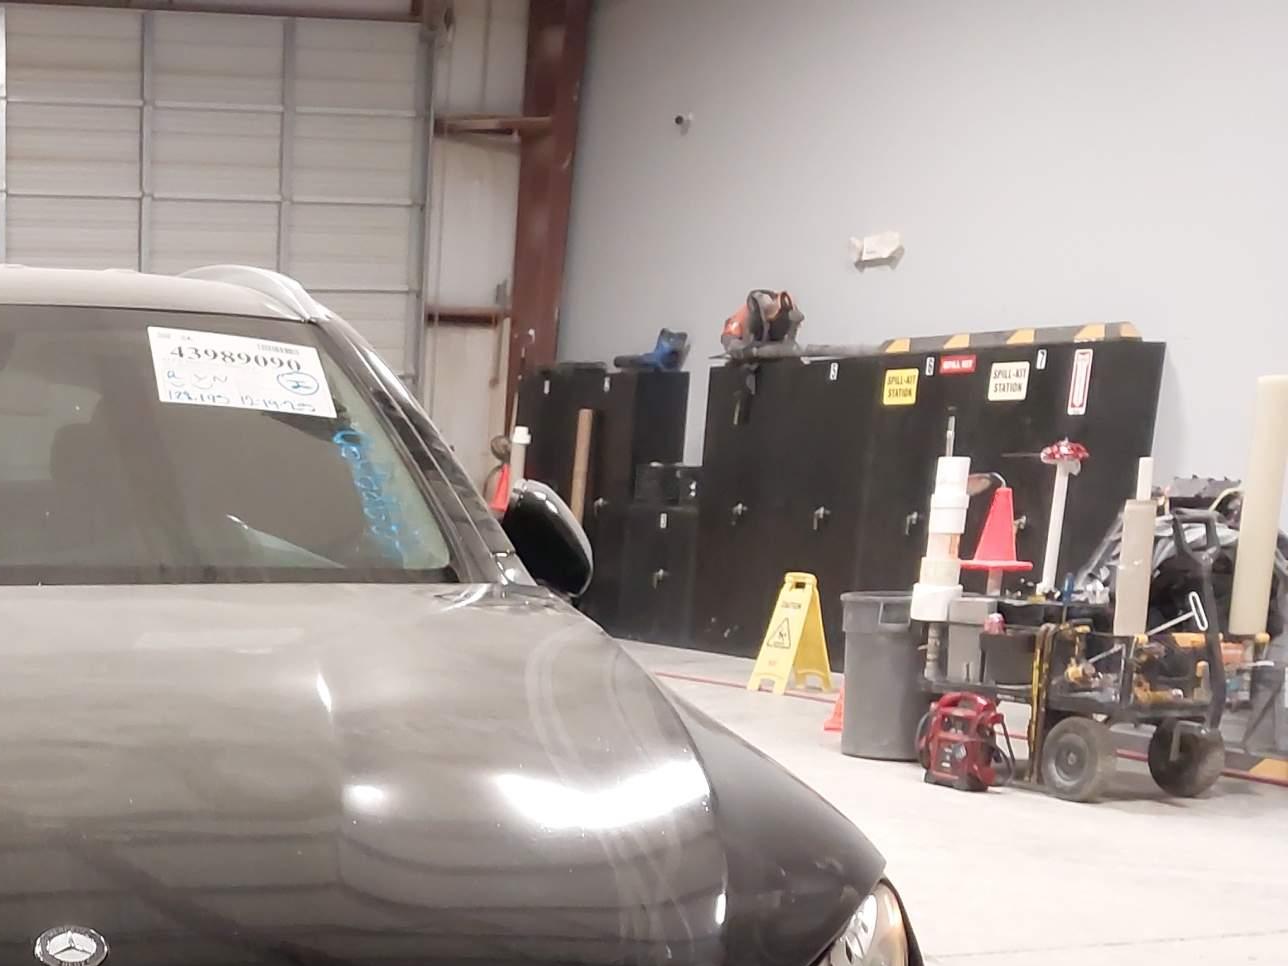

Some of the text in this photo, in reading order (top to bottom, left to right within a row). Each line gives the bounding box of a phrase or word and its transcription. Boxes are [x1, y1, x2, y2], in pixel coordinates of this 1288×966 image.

[170, 345, 302, 371] 43989090
[993, 367, 1027, 379] SPILL-KIT
[887, 374, 916, 385] SPILL-KIT
[887, 387, 912, 398] STATION
[993, 381, 1022, 393] STATION
